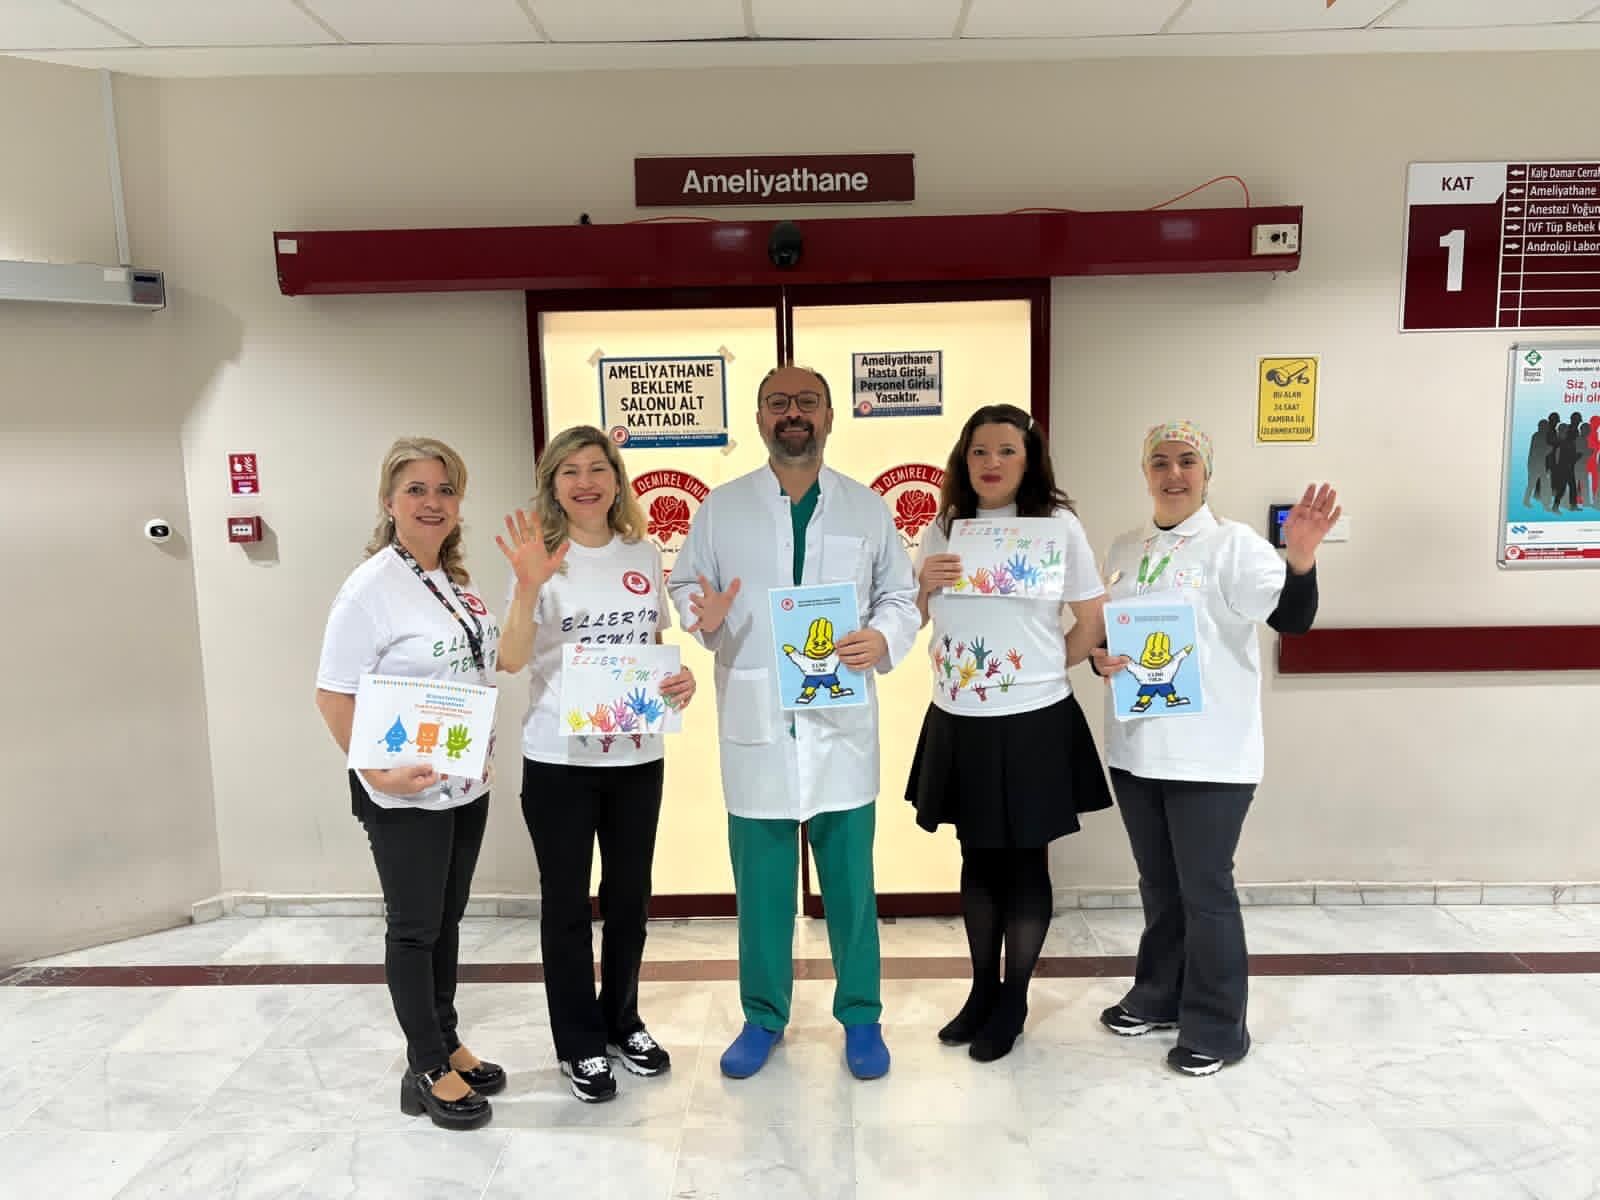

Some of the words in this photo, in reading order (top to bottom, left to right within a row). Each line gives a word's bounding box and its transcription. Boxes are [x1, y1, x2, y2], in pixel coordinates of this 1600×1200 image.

[1531, 167, 1548, 178] Kalp
[1550, 167, 1576, 178] Damar
[682, 168, 868, 197] Ameliyathane
[1441, 177, 1474, 191] KAT
[1530, 184, 1596, 197] Ameliyathane
[1529, 203, 1569, 215] Anestezi
[1528, 222, 1544, 233] IVF
[1545, 221, 1563, 234] Tüp
[1566, 220, 1595, 232] Bebek
[1527, 240, 1571, 253] Androloji
[1439, 229, 1465, 292] 1
[861, 353, 933, 366] Ameliyathane
[609, 362, 714, 379] AMELİYATHANE
[868, 367, 897, 378] Hasta
[900, 366, 926, 378] Girişi
[631, 380, 693, 394] BEKLEME
[860, 380, 905, 391] Personel
[908, 377, 934, 390] Girişi
[620, 397, 676, 411] SALONU
[680, 396, 704, 410] ALT
[875, 392, 920, 403] Yasaktır.
[1564, 391, 1583, 403] biri
[627, 413, 700, 427] KATTADIR.
